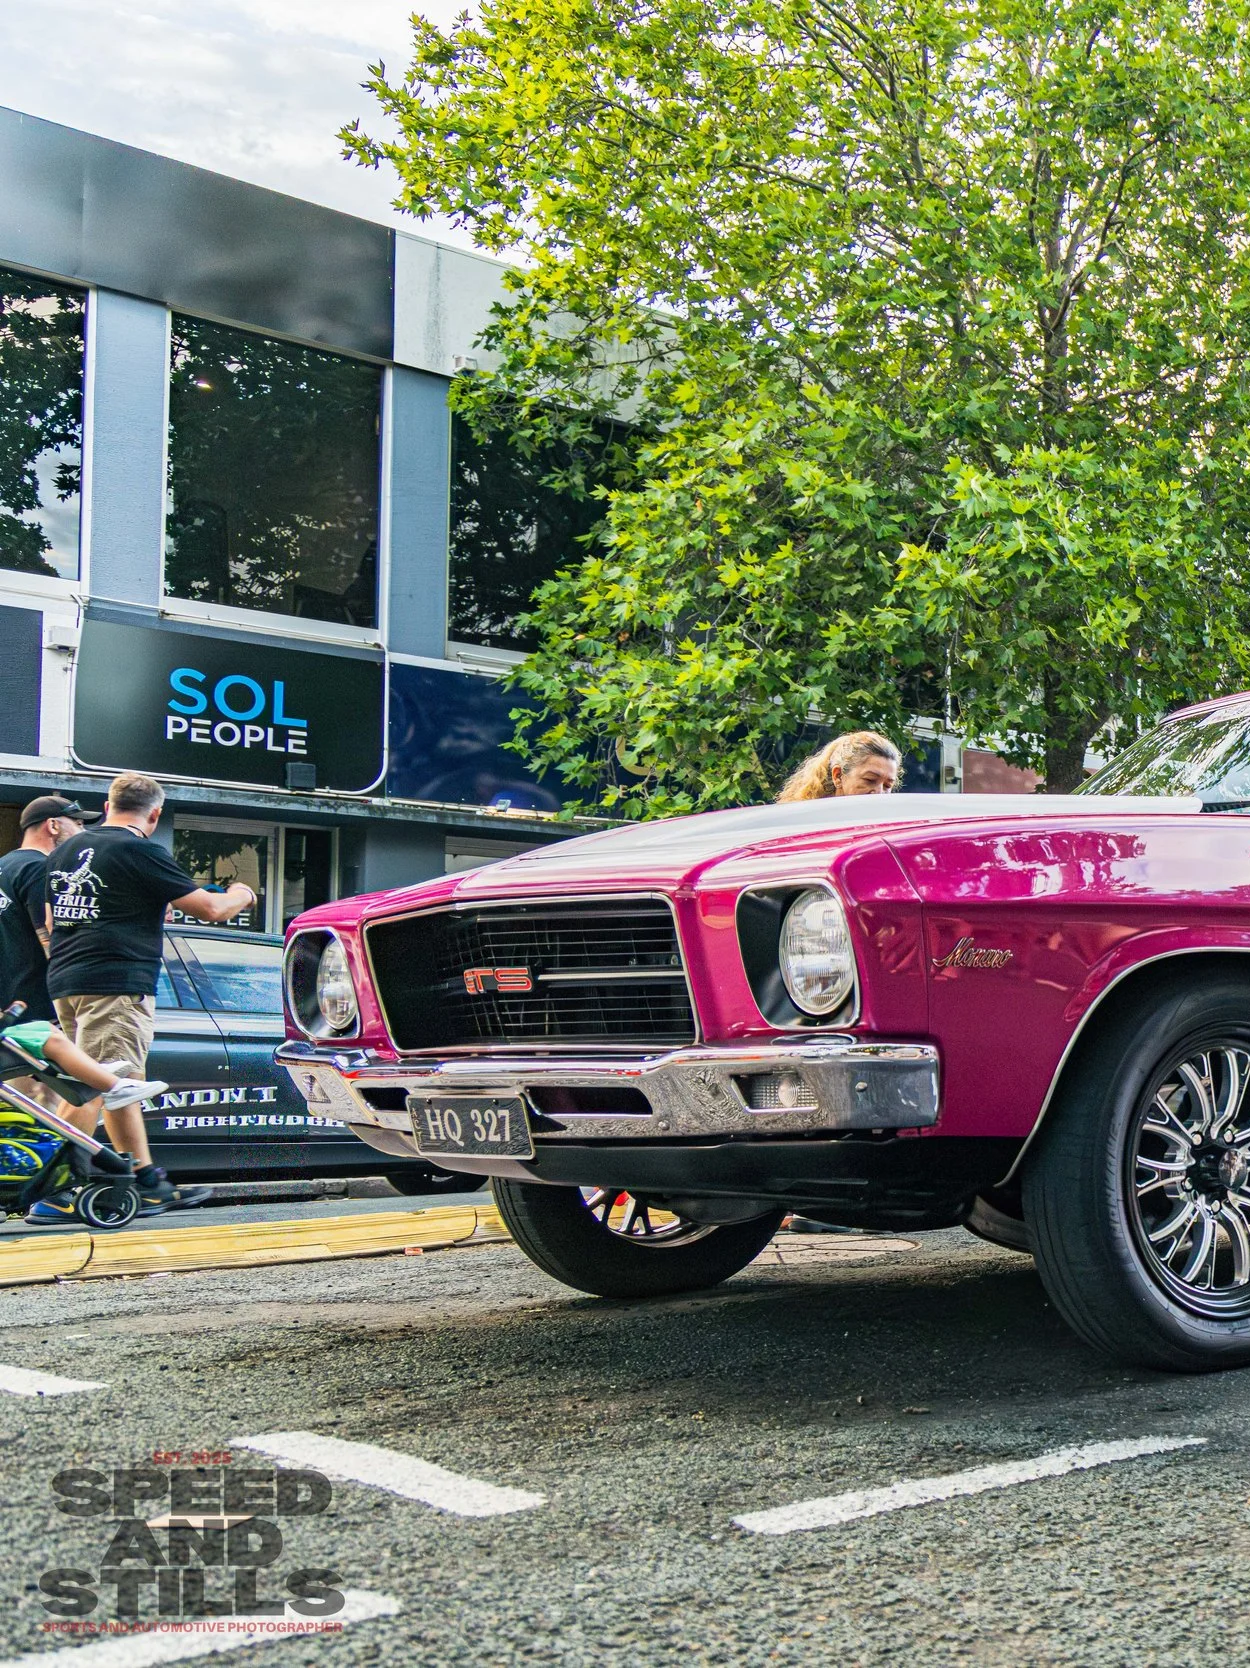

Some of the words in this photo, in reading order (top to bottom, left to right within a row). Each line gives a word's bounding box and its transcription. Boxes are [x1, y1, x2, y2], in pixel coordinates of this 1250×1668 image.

[168, 667, 308, 728] SOL
[166, 715, 308, 754] PEOPLE
[171, 909, 251, 926] PELE
[463, 967, 533, 995] GTS
[424, 1109, 465, 1147] HQ
[470, 1109, 510, 1142] 327
